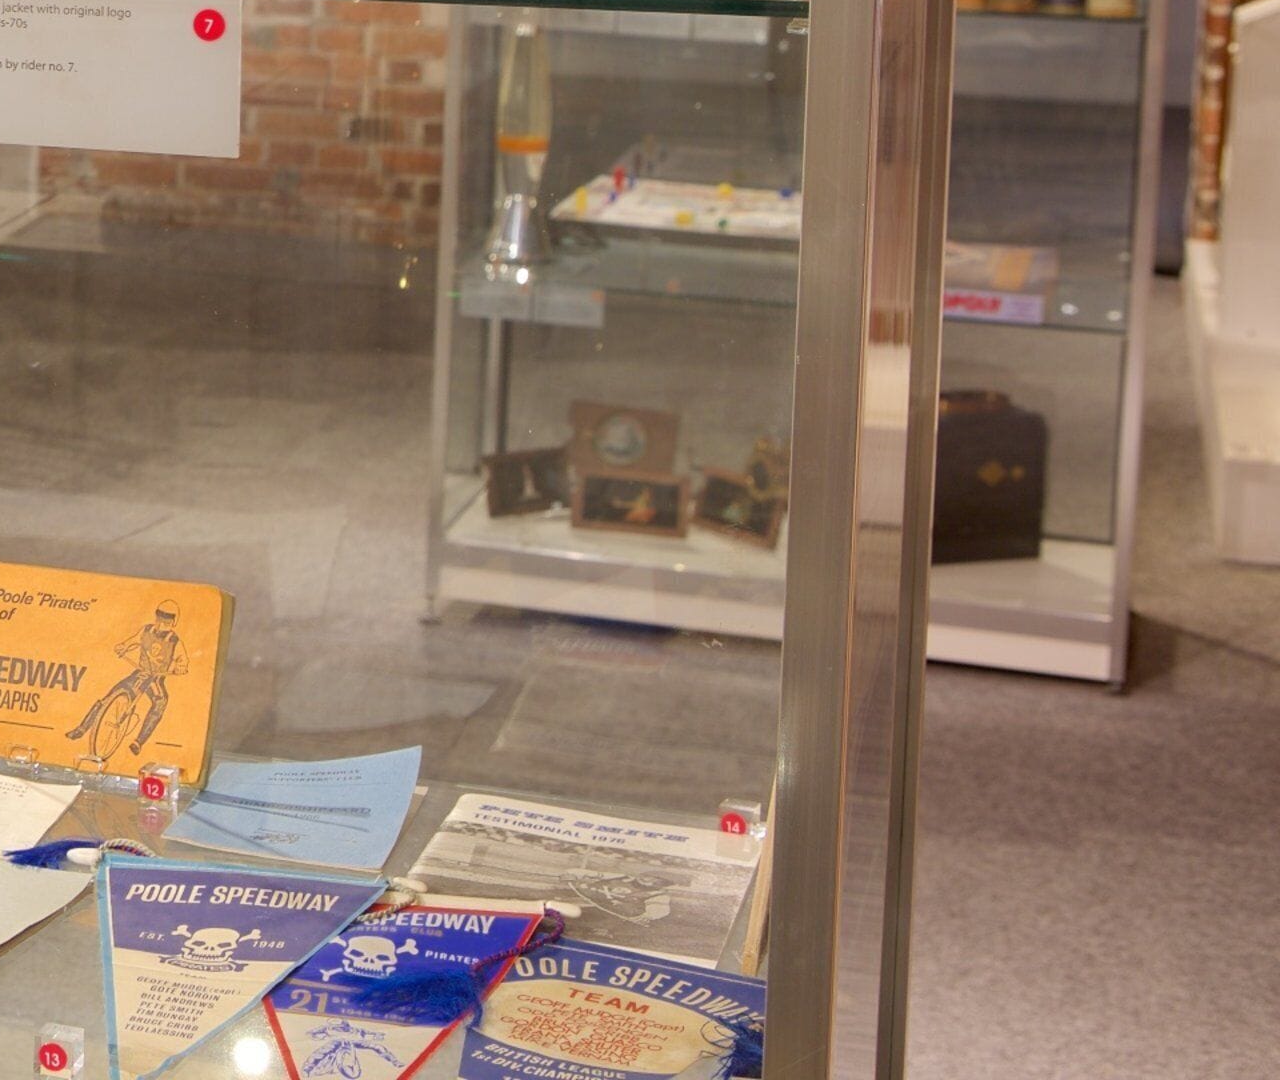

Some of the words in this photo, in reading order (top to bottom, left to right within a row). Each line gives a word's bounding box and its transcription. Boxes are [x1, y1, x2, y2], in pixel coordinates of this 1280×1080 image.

[0, 2, 35, 17] jacket
[35, 3, 60, 16] with
[62, 4, 104, 20] original
[105, 5, 132, 21] logo
[204, 18, 215, 34] 7
[3, 58, 18, 73] by
[20, 58, 46, 72] rider
[48, 62, 65, 73] no.
[67, 60, 78, 73] 7.
[36, 591, 98, 612] "Pirates"
[145, 781, 160, 796] 12
[473, 812, 581, 839] TESTIMONIAL
[590, 833, 627, 845] 1976
[478, 803, 565, 824] PETE
[573, 820, 690, 843] SMITH
[725, 820, 741, 833] 14
[125, 883, 207, 905] POOLE
[209, 885, 340, 913] SPEEDWAY
[138, 931, 166, 942] EST.
[252, 939, 286, 950] 1948
[514, 956, 600, 982] OOLE
[165, 996, 215, 1009] ANDREWS
[289, 988, 328, 1013] 21
[567, 986, 651, 1015] TEAM
[168, 1005, 204, 1016] SMITH
[44, 1051, 60, 1067] 13
[484, 1043, 553, 1068] BRITISH
[557, 1061, 627, 1080] LEAGUE
